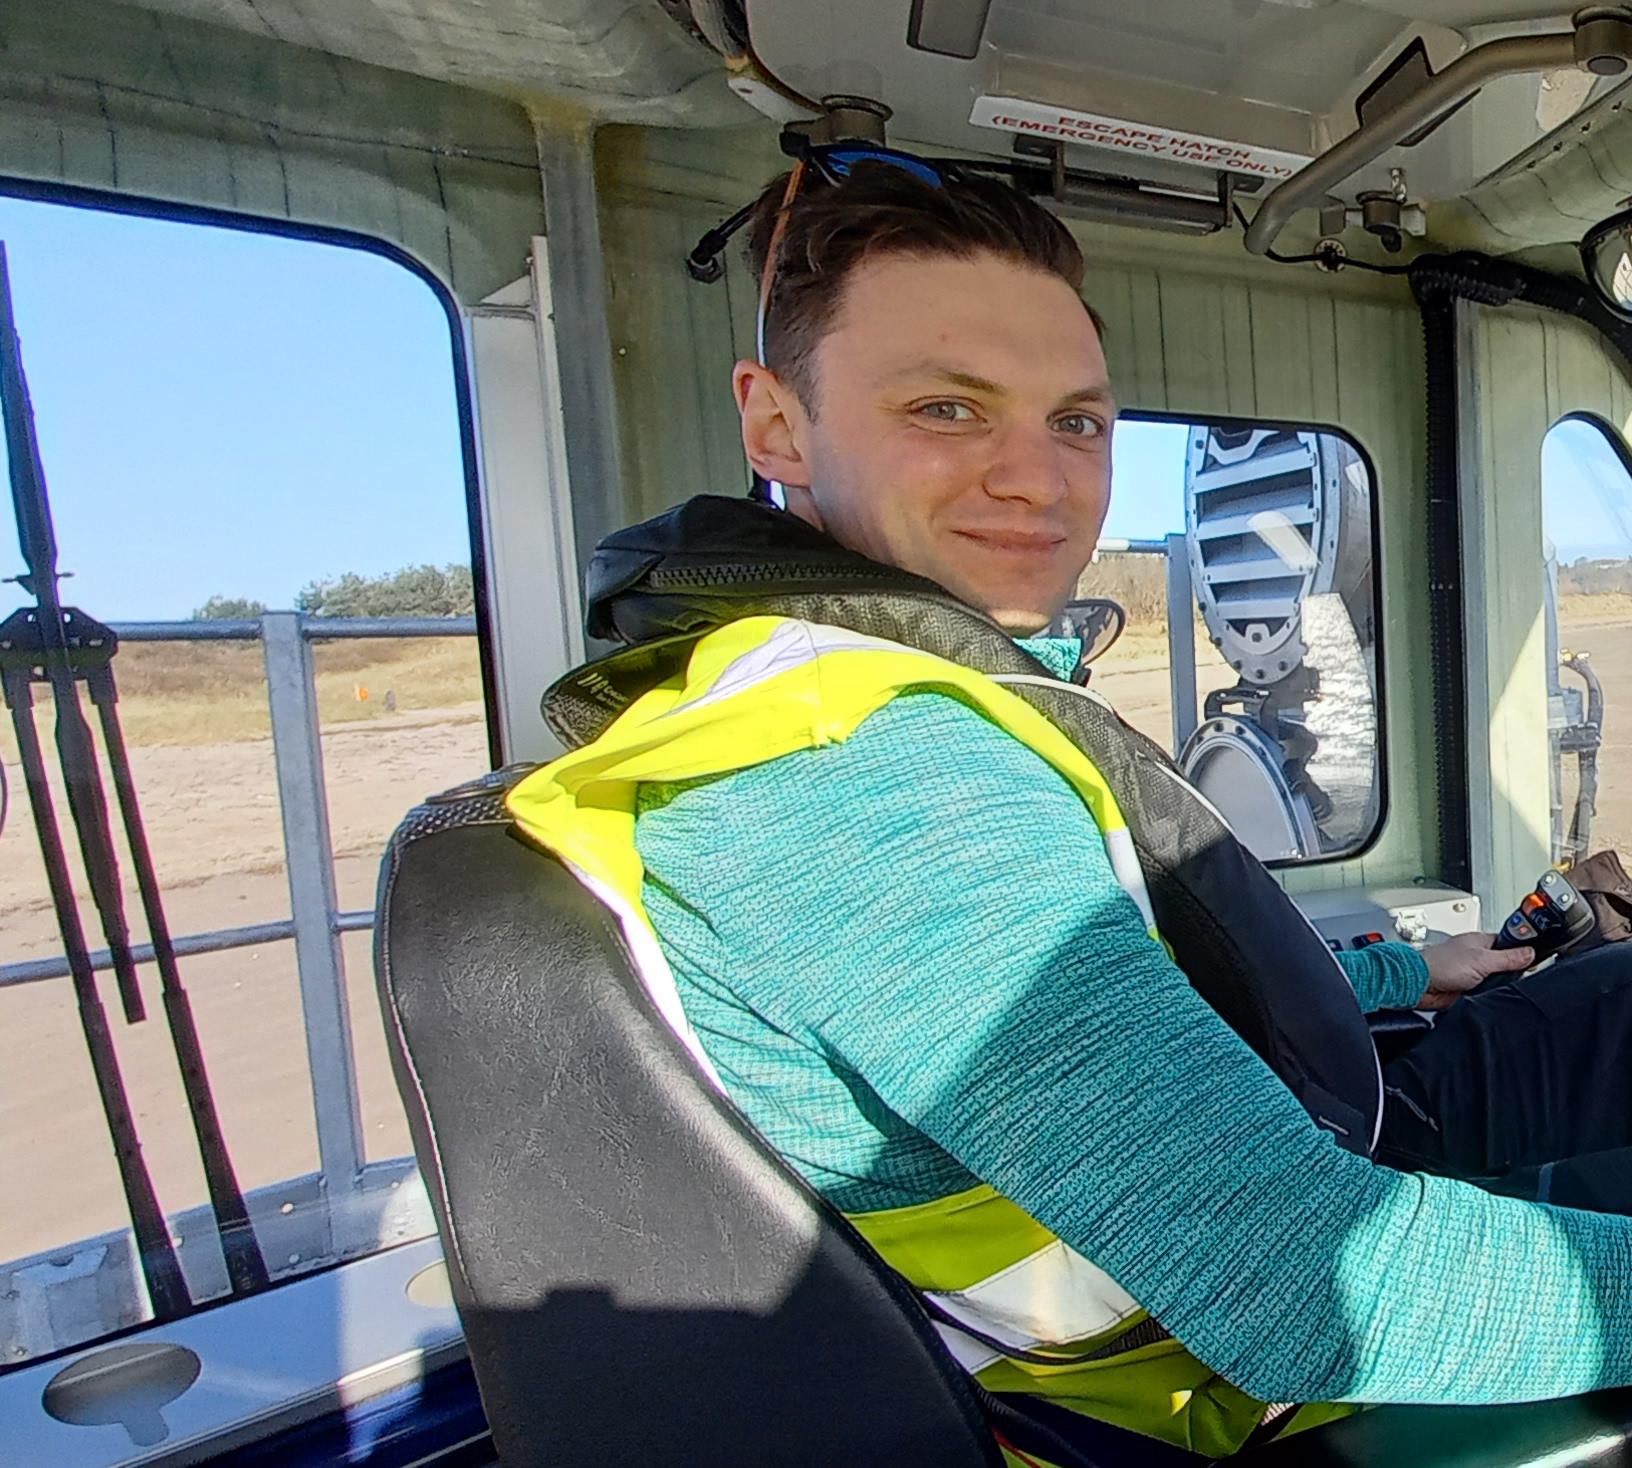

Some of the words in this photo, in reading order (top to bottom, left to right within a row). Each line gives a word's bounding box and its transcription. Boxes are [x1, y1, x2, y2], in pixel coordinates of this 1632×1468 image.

[991, 115, 1167, 152] (EMERGENCY
[1172, 148, 1221, 164] USE
[1226, 159, 1293, 177] ONLY)
[1058, 116, 1164, 142] ESCAPE
[1169, 137, 1251, 159] HATCH
